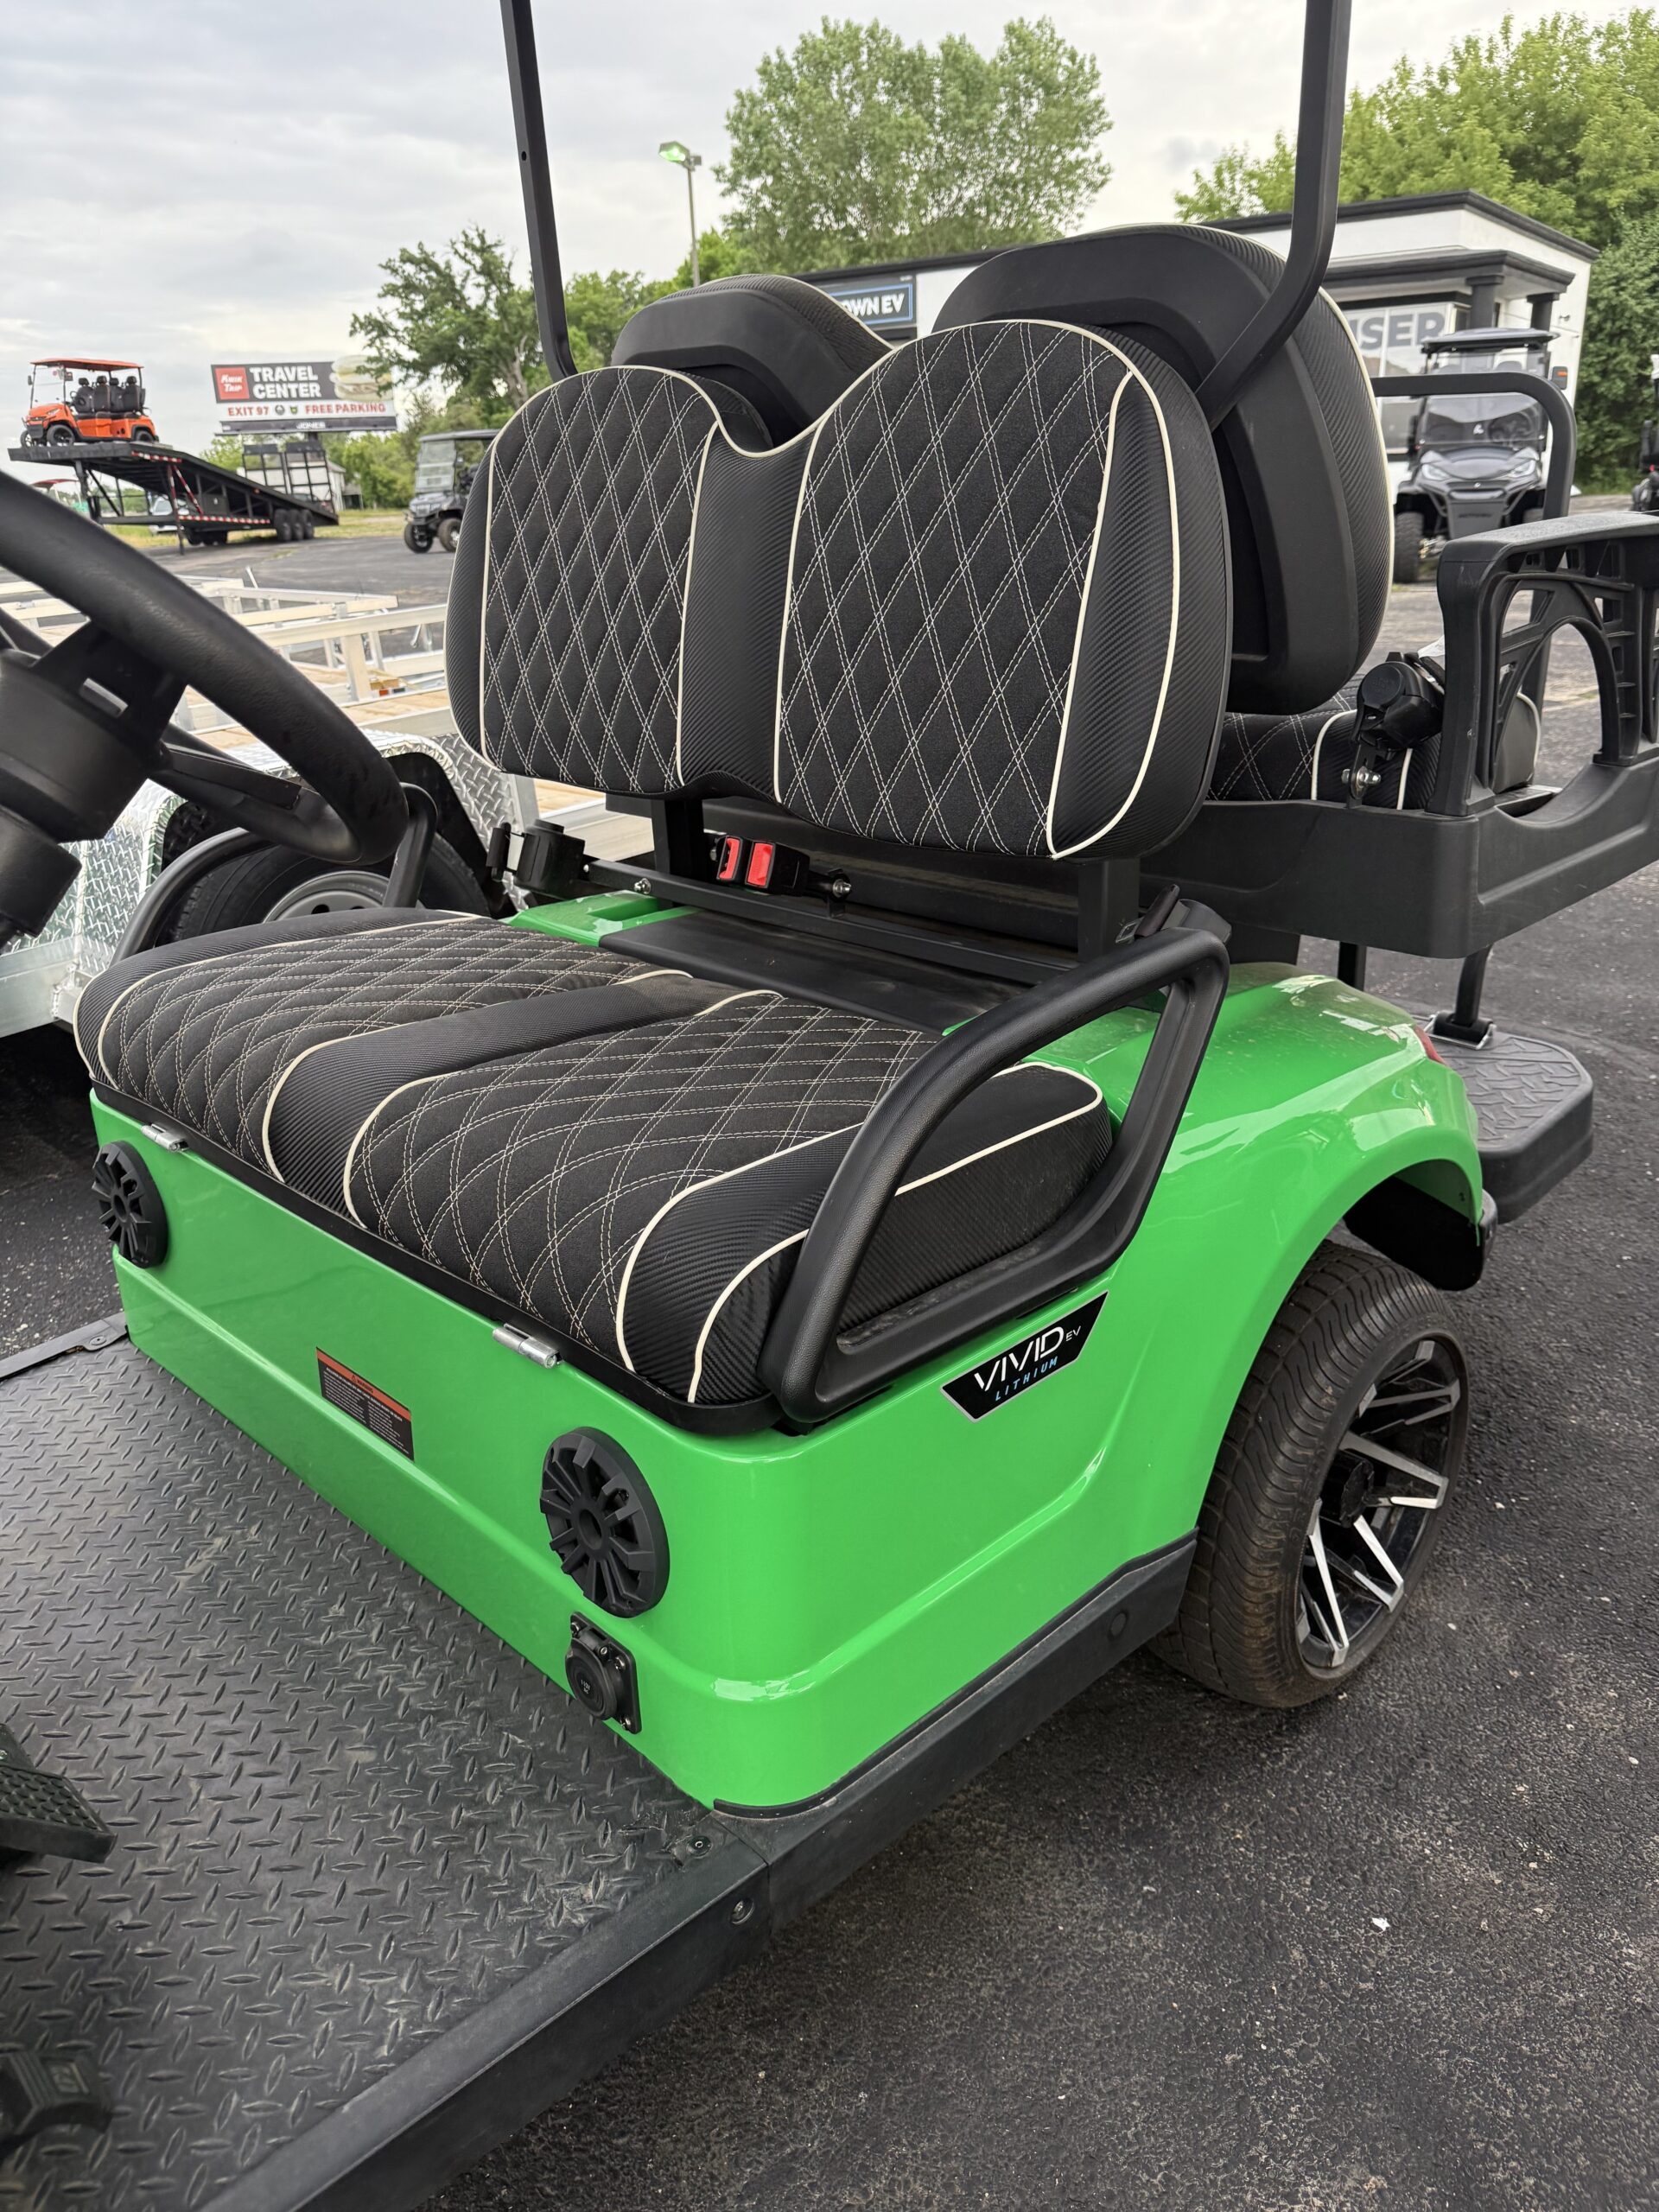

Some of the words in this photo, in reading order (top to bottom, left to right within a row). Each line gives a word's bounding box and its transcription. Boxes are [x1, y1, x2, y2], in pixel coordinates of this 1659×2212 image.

[881, 293, 906, 314] EV
[249, 365, 319, 382] TRAVEL
[252, 382, 322, 399] CENTER
[227, 406, 254, 416] EXIT
[256, 406, 269, 416] 97
[305, 404, 333, 414] FREE
[335, 403, 386, 413] PARKING
[974, 1326, 1065, 1391] VIVID
[1065, 1325, 1081, 1341] EV
[995, 1356, 1058, 1401] LITHIUM
